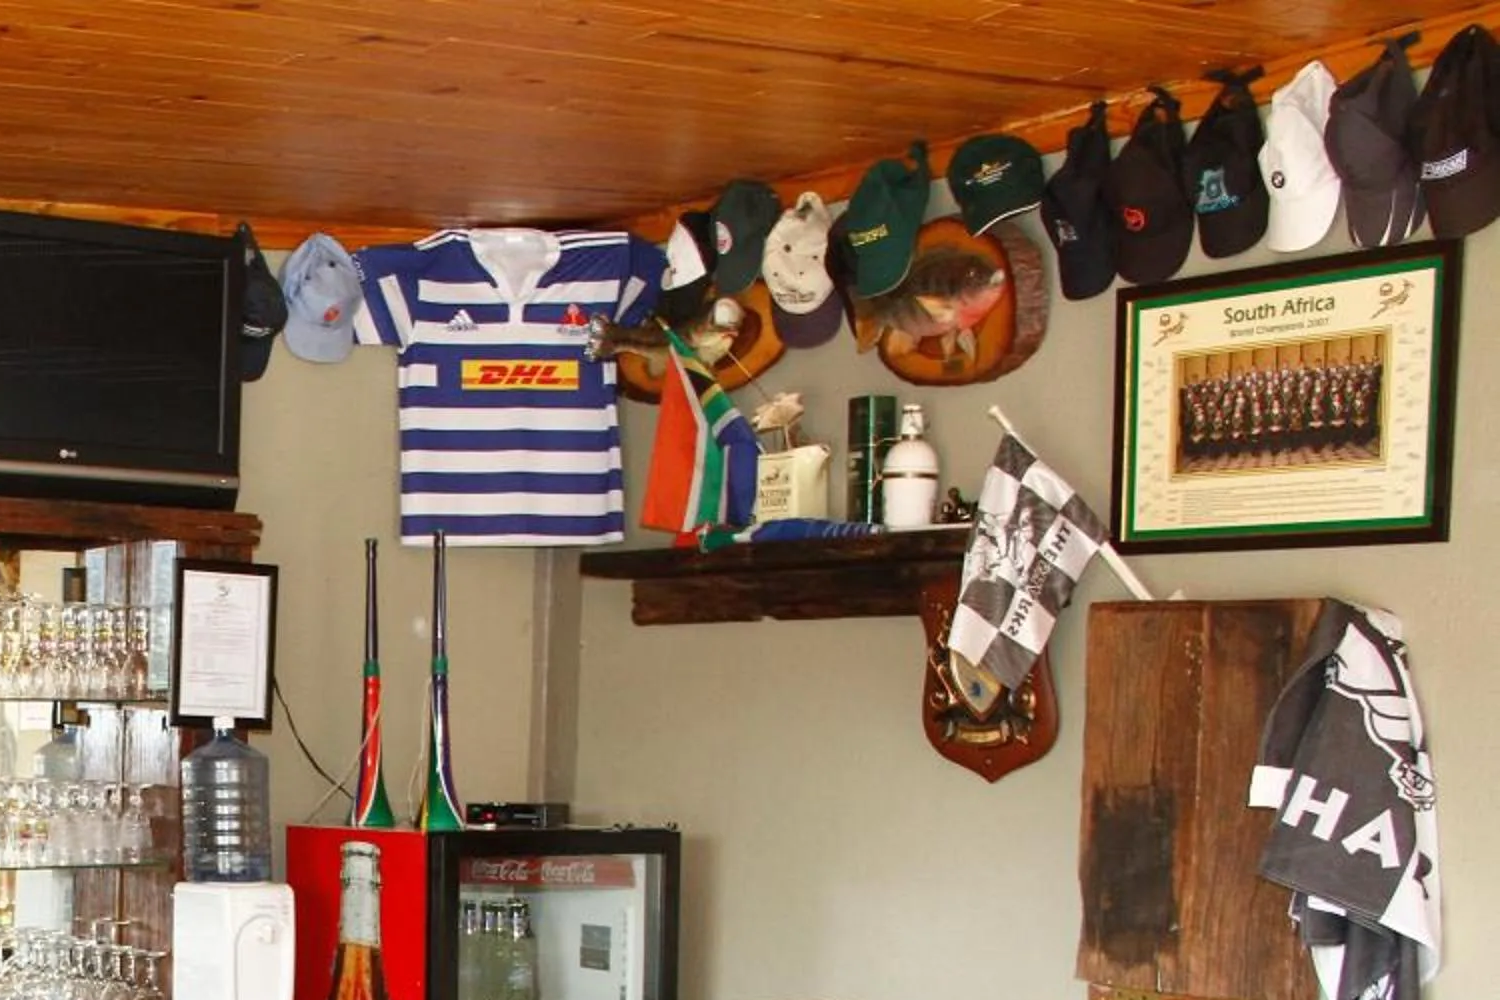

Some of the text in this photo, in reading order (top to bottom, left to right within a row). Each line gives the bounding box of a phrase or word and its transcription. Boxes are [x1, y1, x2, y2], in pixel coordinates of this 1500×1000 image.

[1223, 296, 1335, 325] South Africa
[478, 365, 562, 385] DHL
